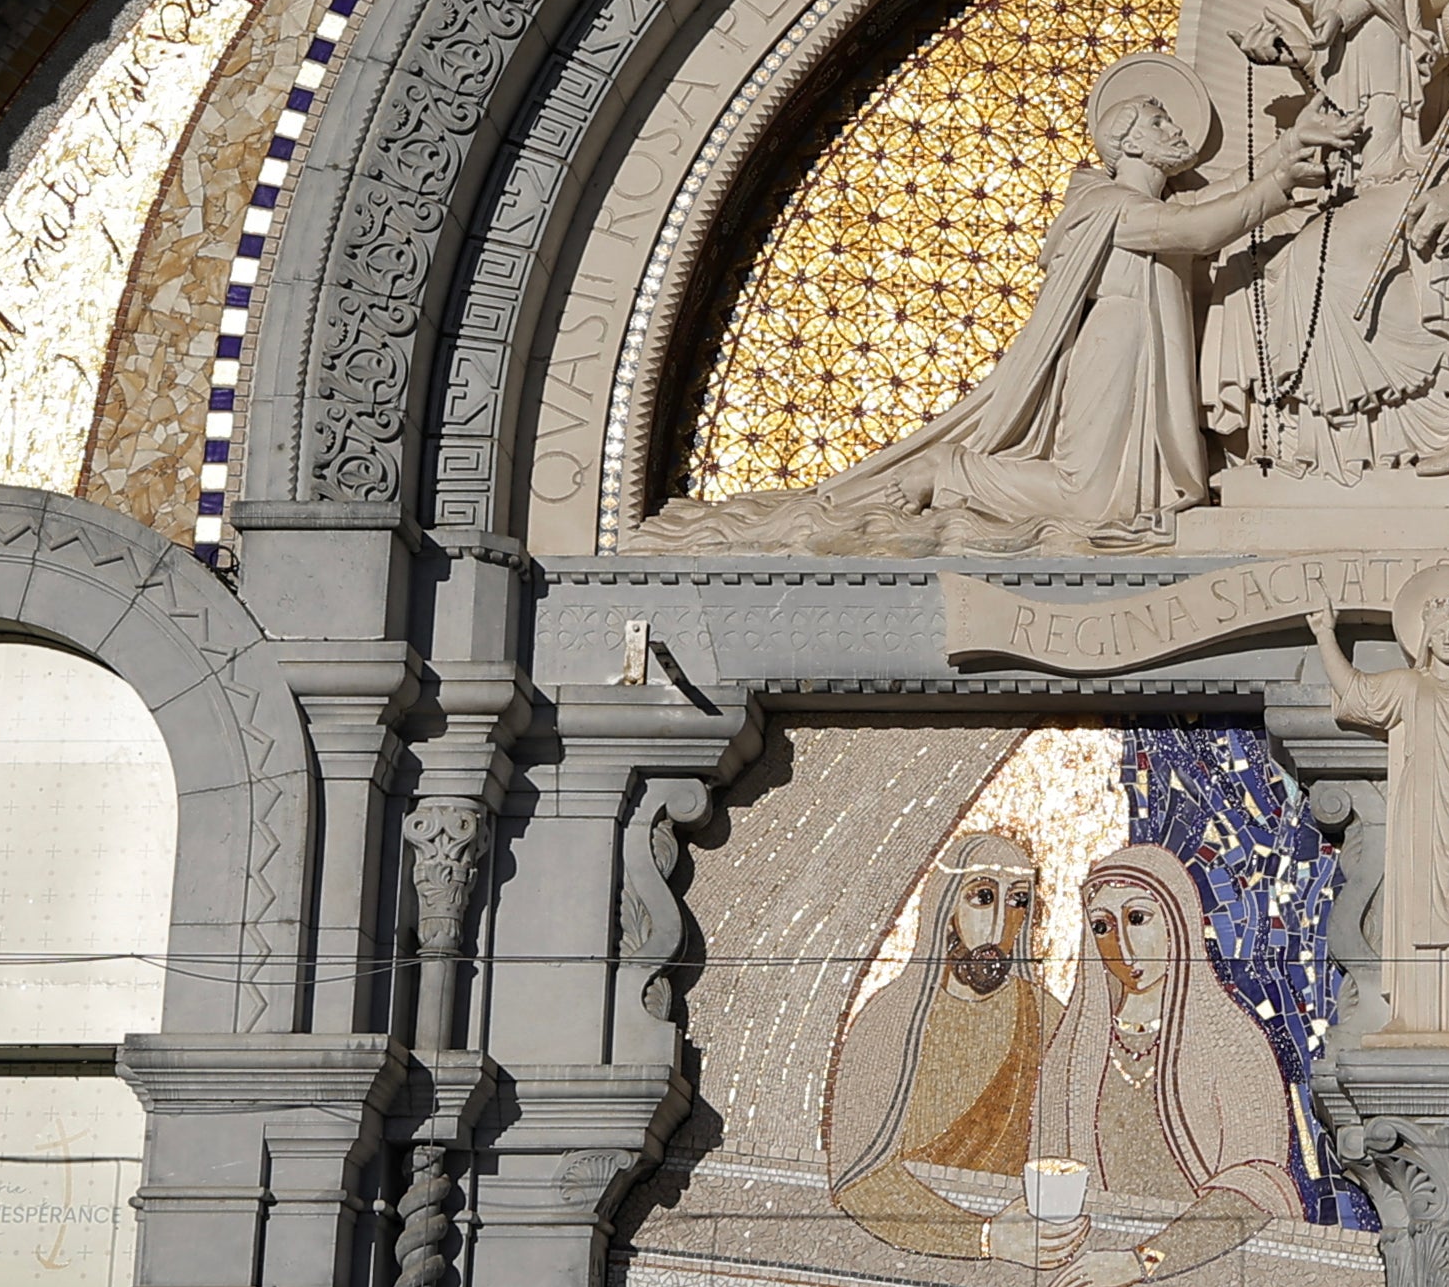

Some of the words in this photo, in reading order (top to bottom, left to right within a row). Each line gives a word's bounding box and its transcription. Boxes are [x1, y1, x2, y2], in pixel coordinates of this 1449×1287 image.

[530, 289, 617, 504] QVASI
[594, 79, 720, 247] ROSA
[1010, 595, 1200, 657] REGINA
